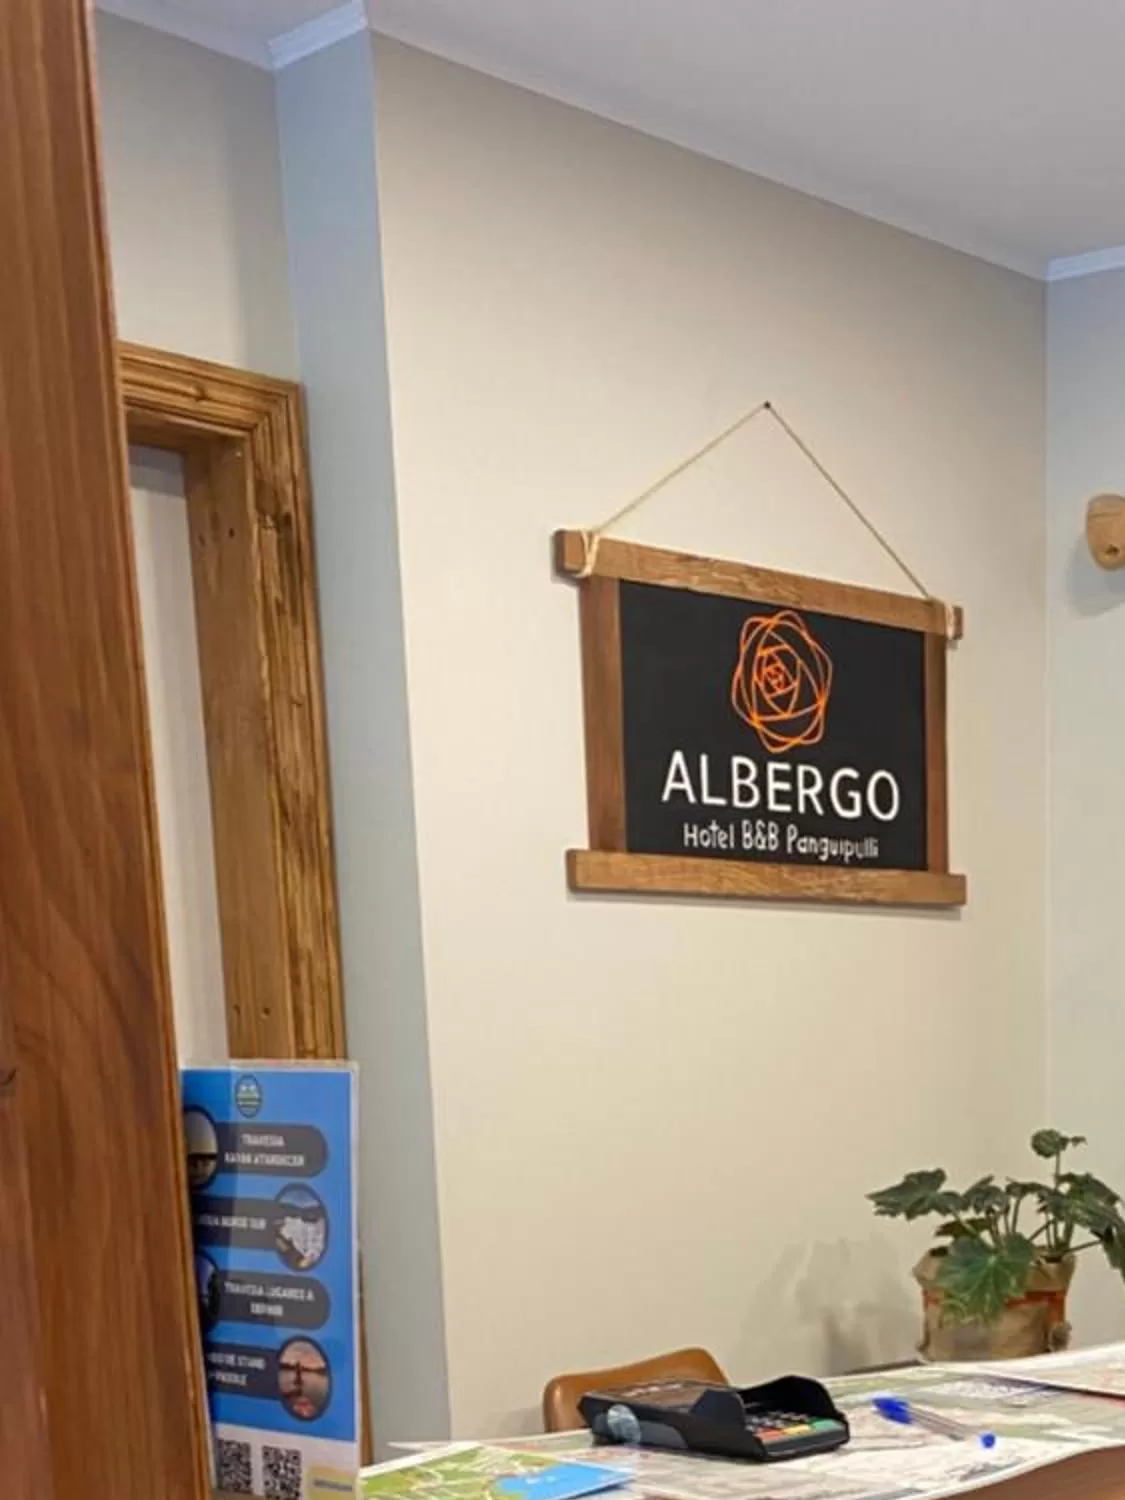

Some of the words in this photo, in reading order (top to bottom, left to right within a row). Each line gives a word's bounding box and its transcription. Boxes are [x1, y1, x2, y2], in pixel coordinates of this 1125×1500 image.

[661, 749, 901, 822] ALBERGO
[683, 819, 735, 849] Hotel
[741, 819, 780, 851] B&B
[785, 823, 880, 864] Panguipulli
